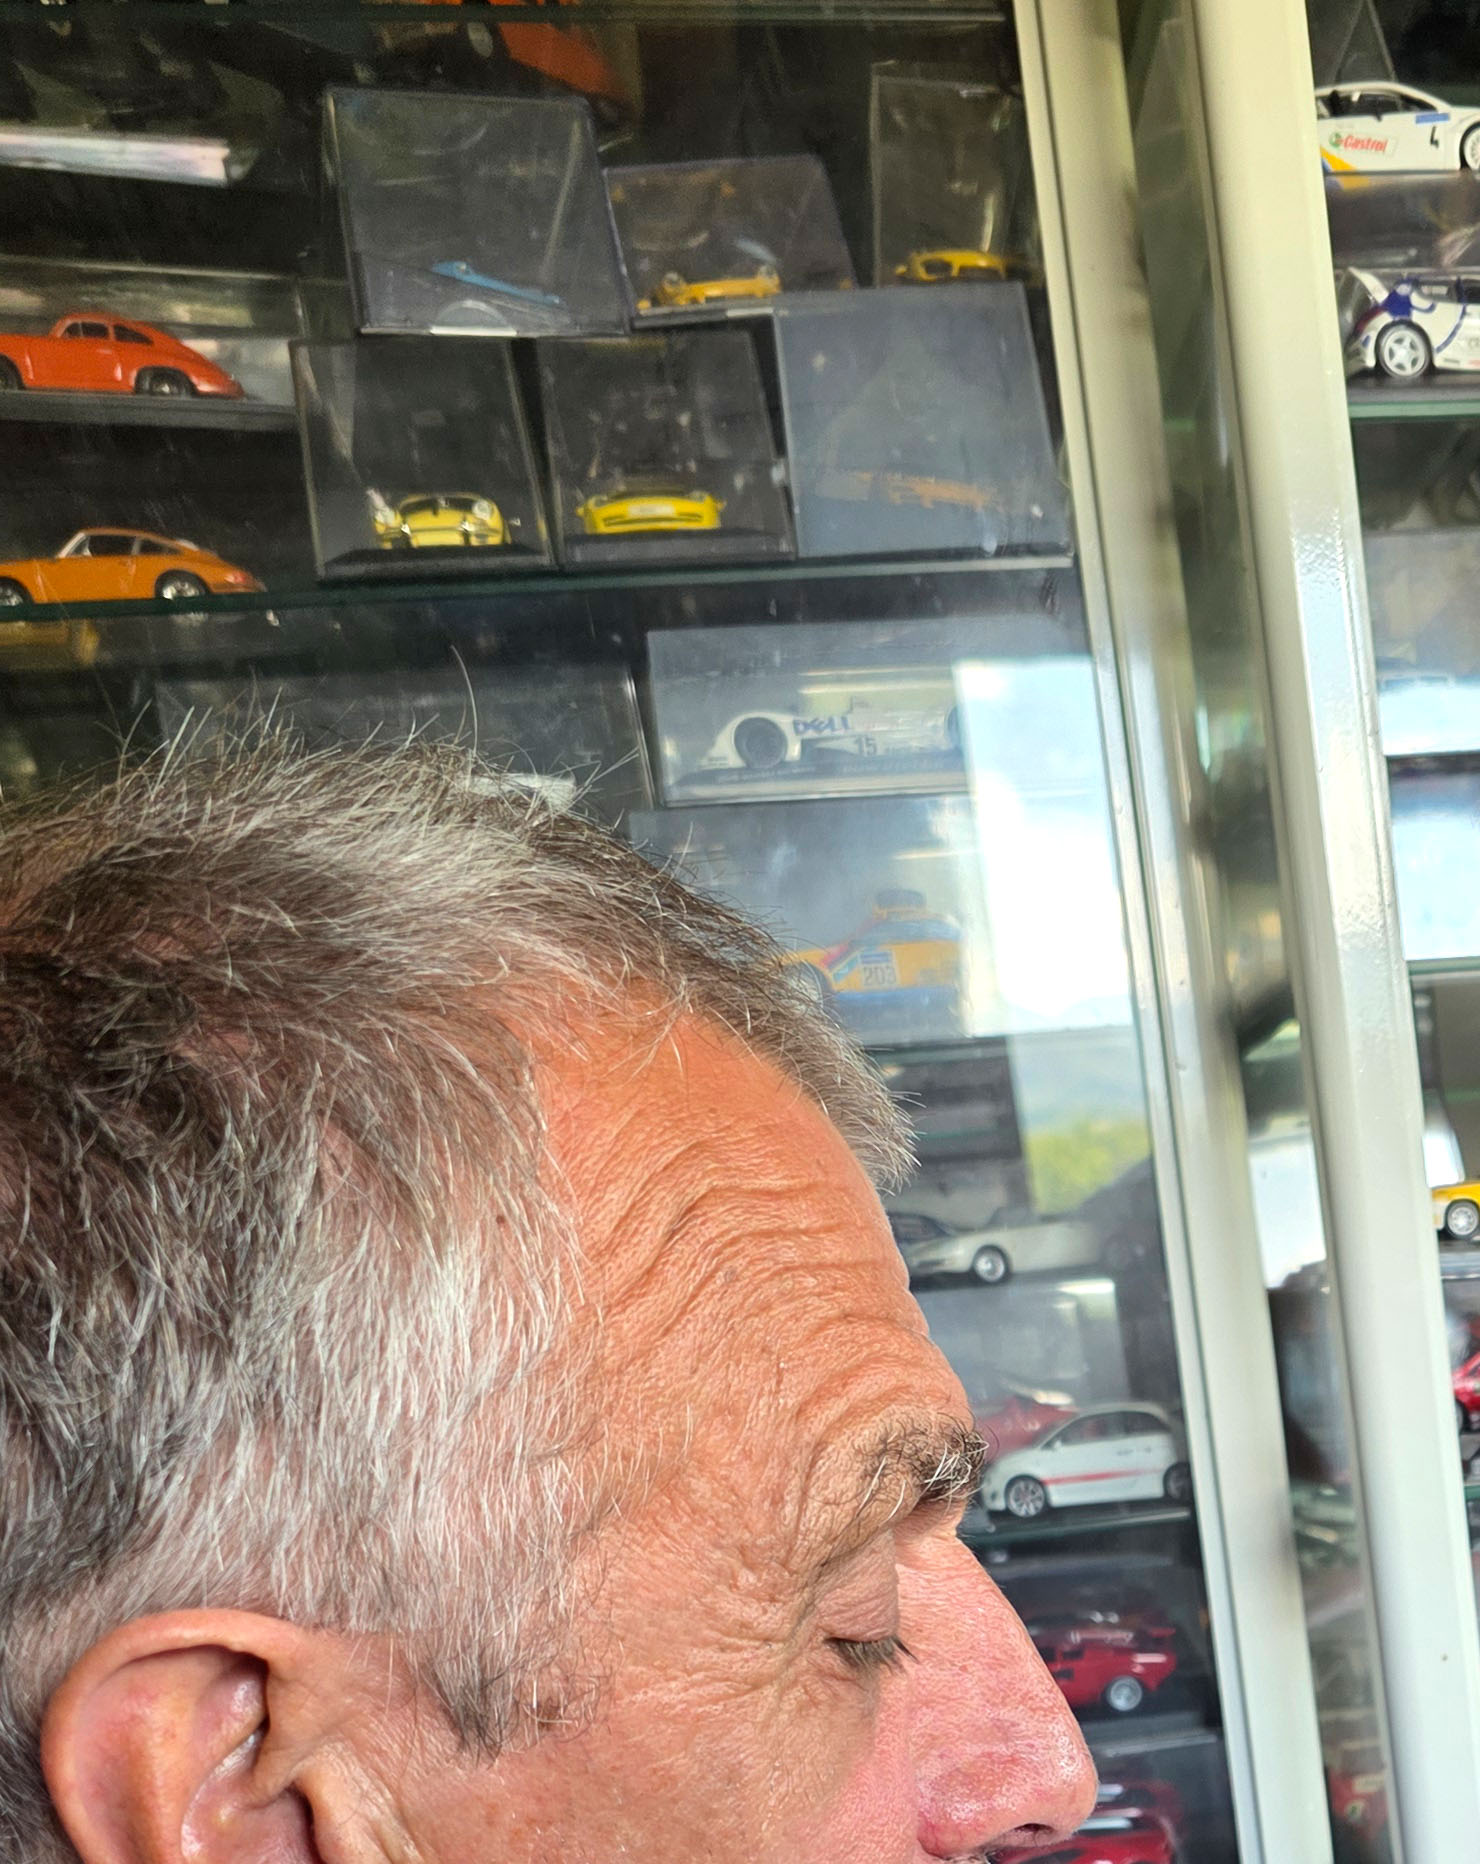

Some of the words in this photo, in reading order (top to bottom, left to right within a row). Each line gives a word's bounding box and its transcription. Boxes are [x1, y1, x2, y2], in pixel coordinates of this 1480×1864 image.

[1343, 133, 1390, 152] Castrol
[1429, 125, 1440, 149] 4
[854, 735, 877, 756] 15
